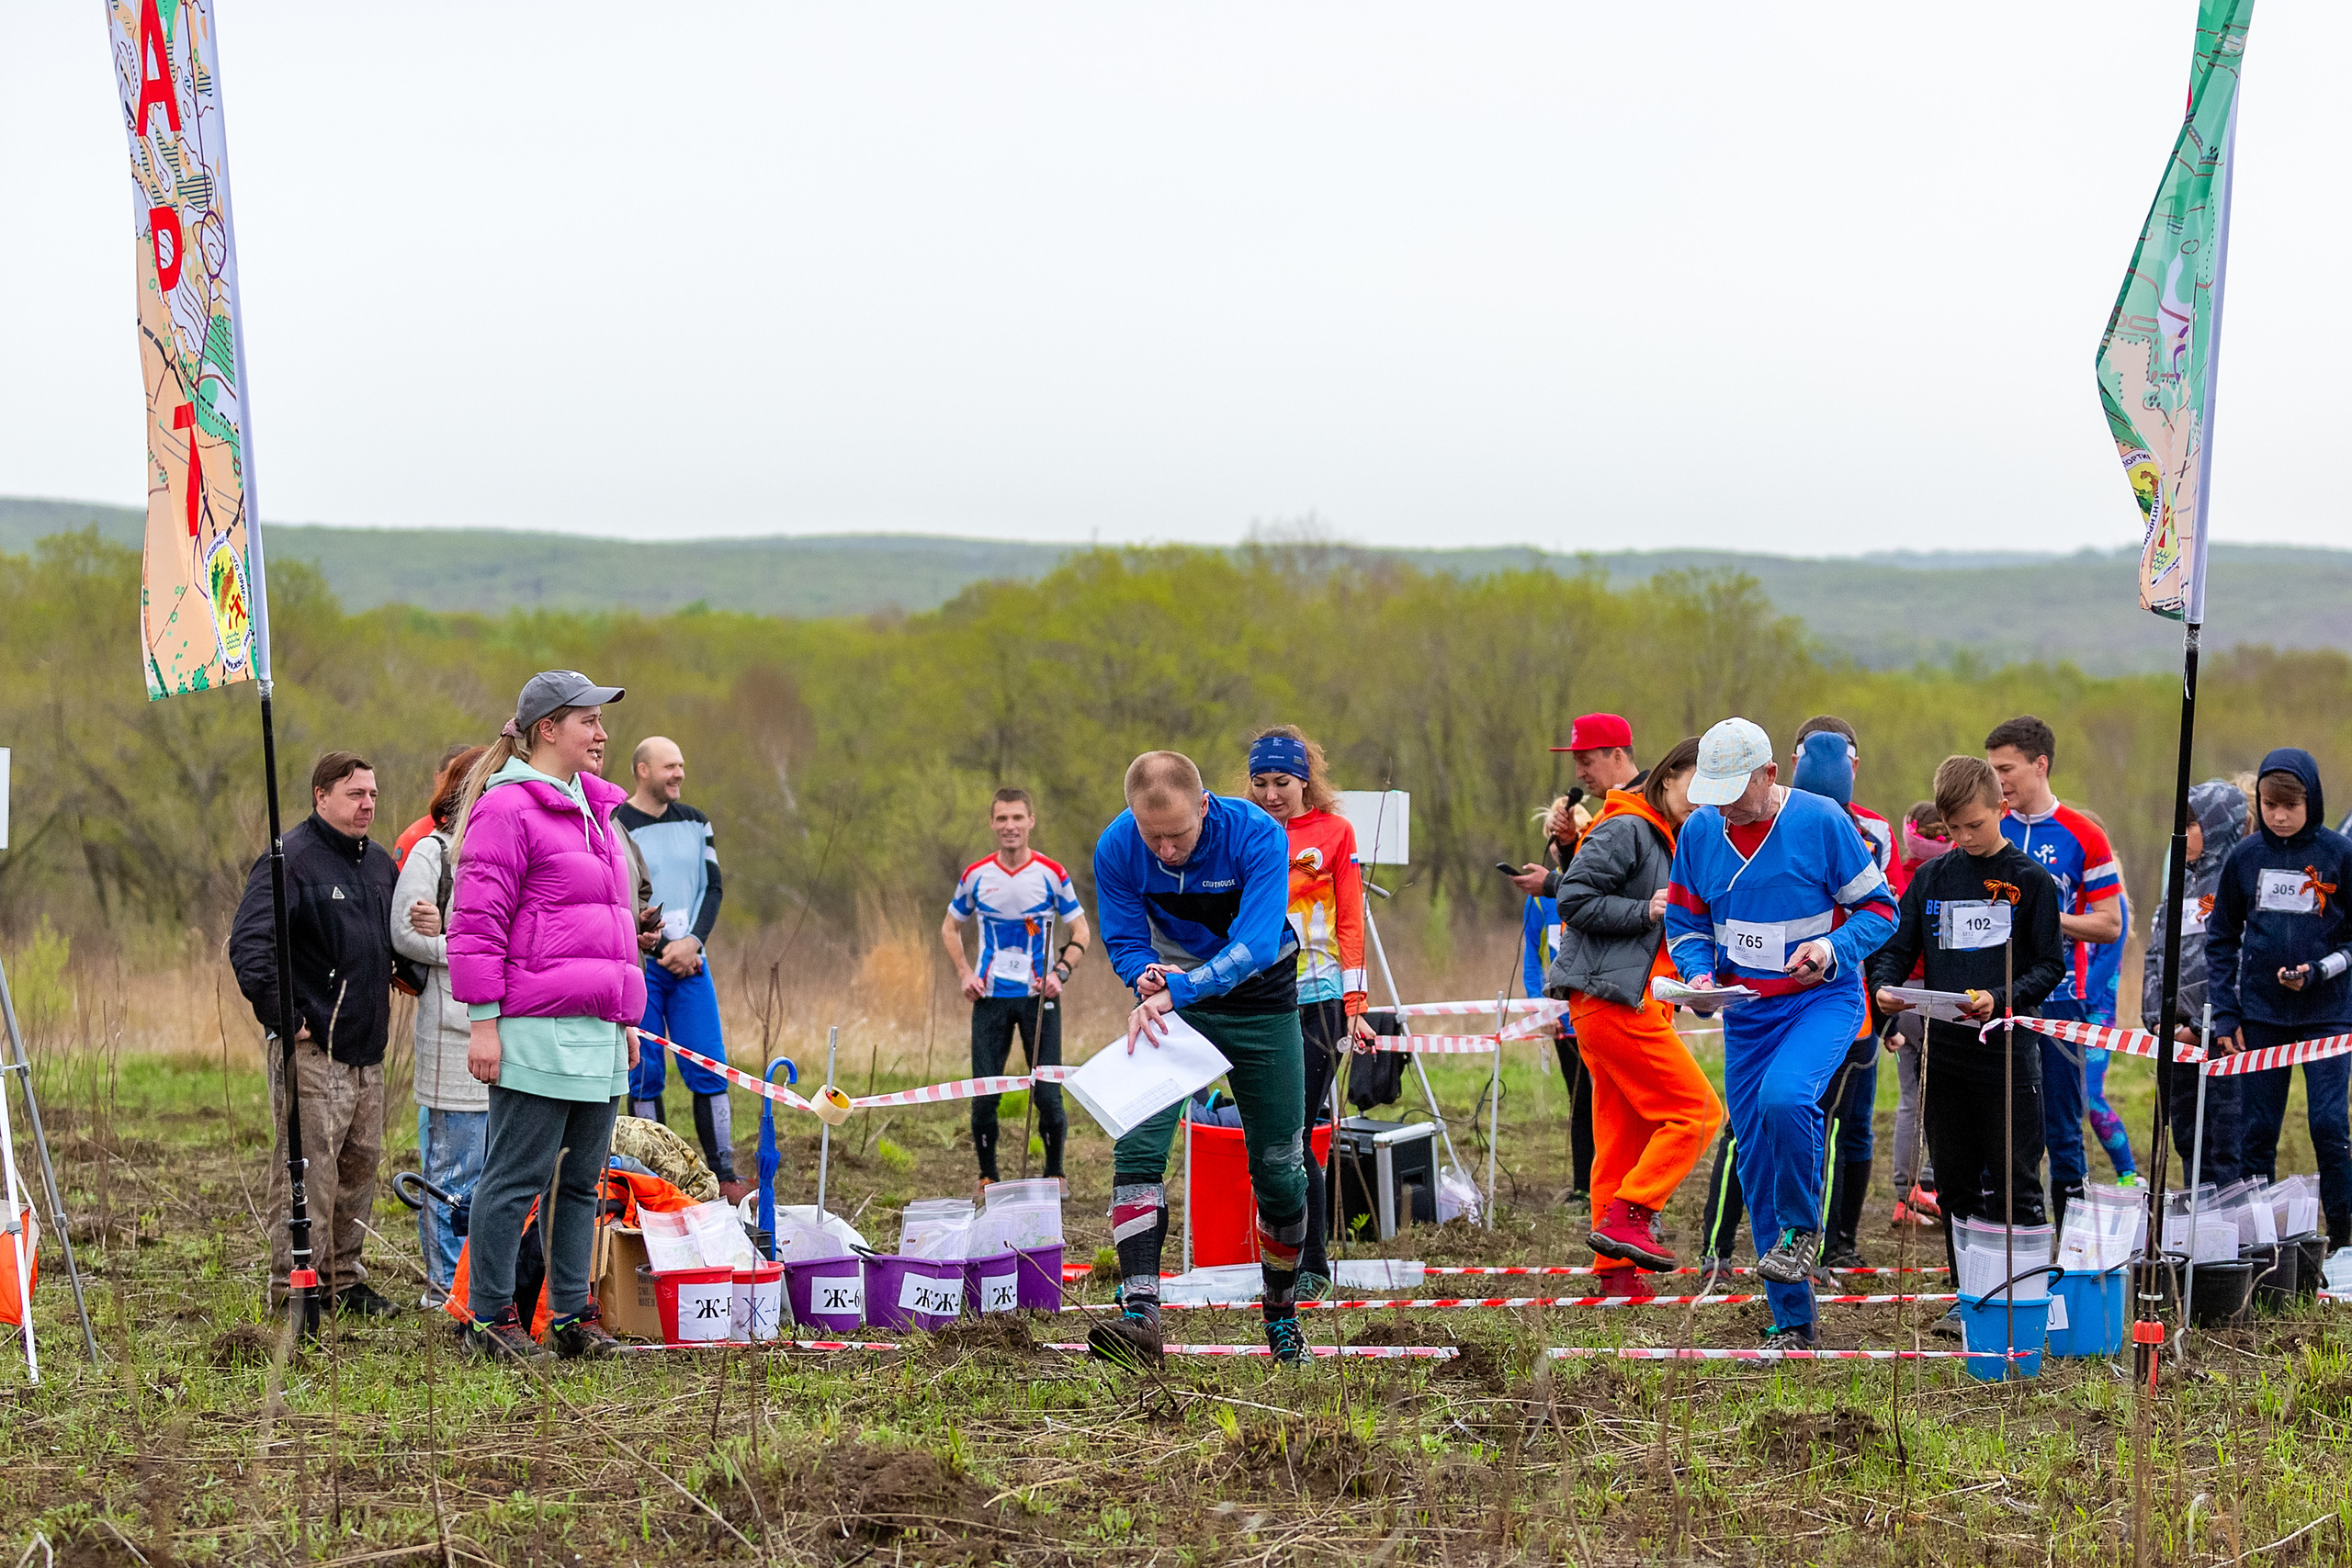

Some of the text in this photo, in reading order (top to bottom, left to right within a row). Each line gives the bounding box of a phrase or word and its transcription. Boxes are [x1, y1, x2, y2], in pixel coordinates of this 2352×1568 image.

[2272, 883, 2295, 896] 305
[1966, 918, 1991, 931] 102
[1736, 933, 1763, 949] 765
[1009, 960, 1020, 969] 12
